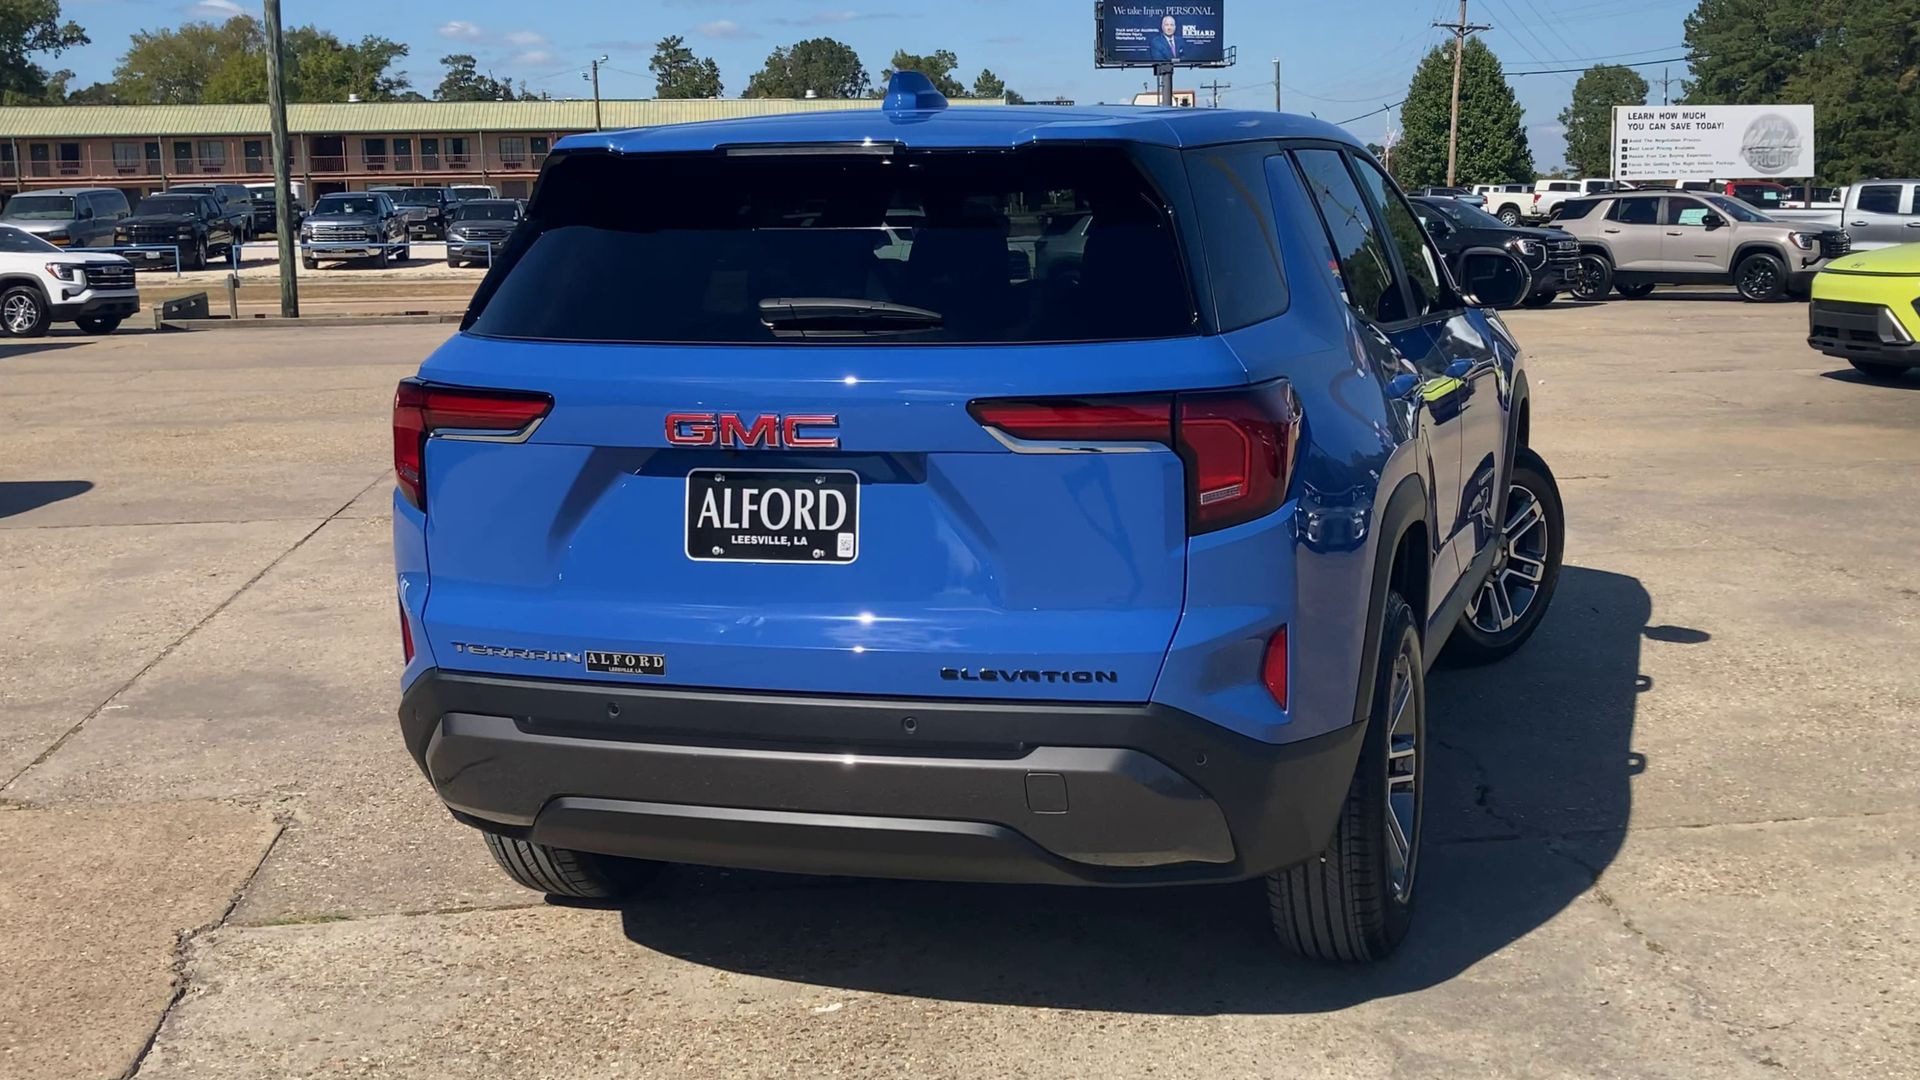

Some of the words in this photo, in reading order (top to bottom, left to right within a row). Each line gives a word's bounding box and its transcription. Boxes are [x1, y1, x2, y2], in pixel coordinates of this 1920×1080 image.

[1114, 6, 1126, 15] We
[1127, 6, 1142, 15] take
[1144, 6, 1165, 17] Injury
[1696, 122, 1724, 130] TODAY!
[664, 413, 839, 449] GMC
[697, 487, 847, 530] ALFORD
[731, 535, 791, 546] LEESVILLE,
[794, 536, 808, 546] LA
[450, 641, 582, 664] TERRAIN
[588, 652, 664, 668] ALFORD
[940, 667, 1118, 684] ELEVATION
